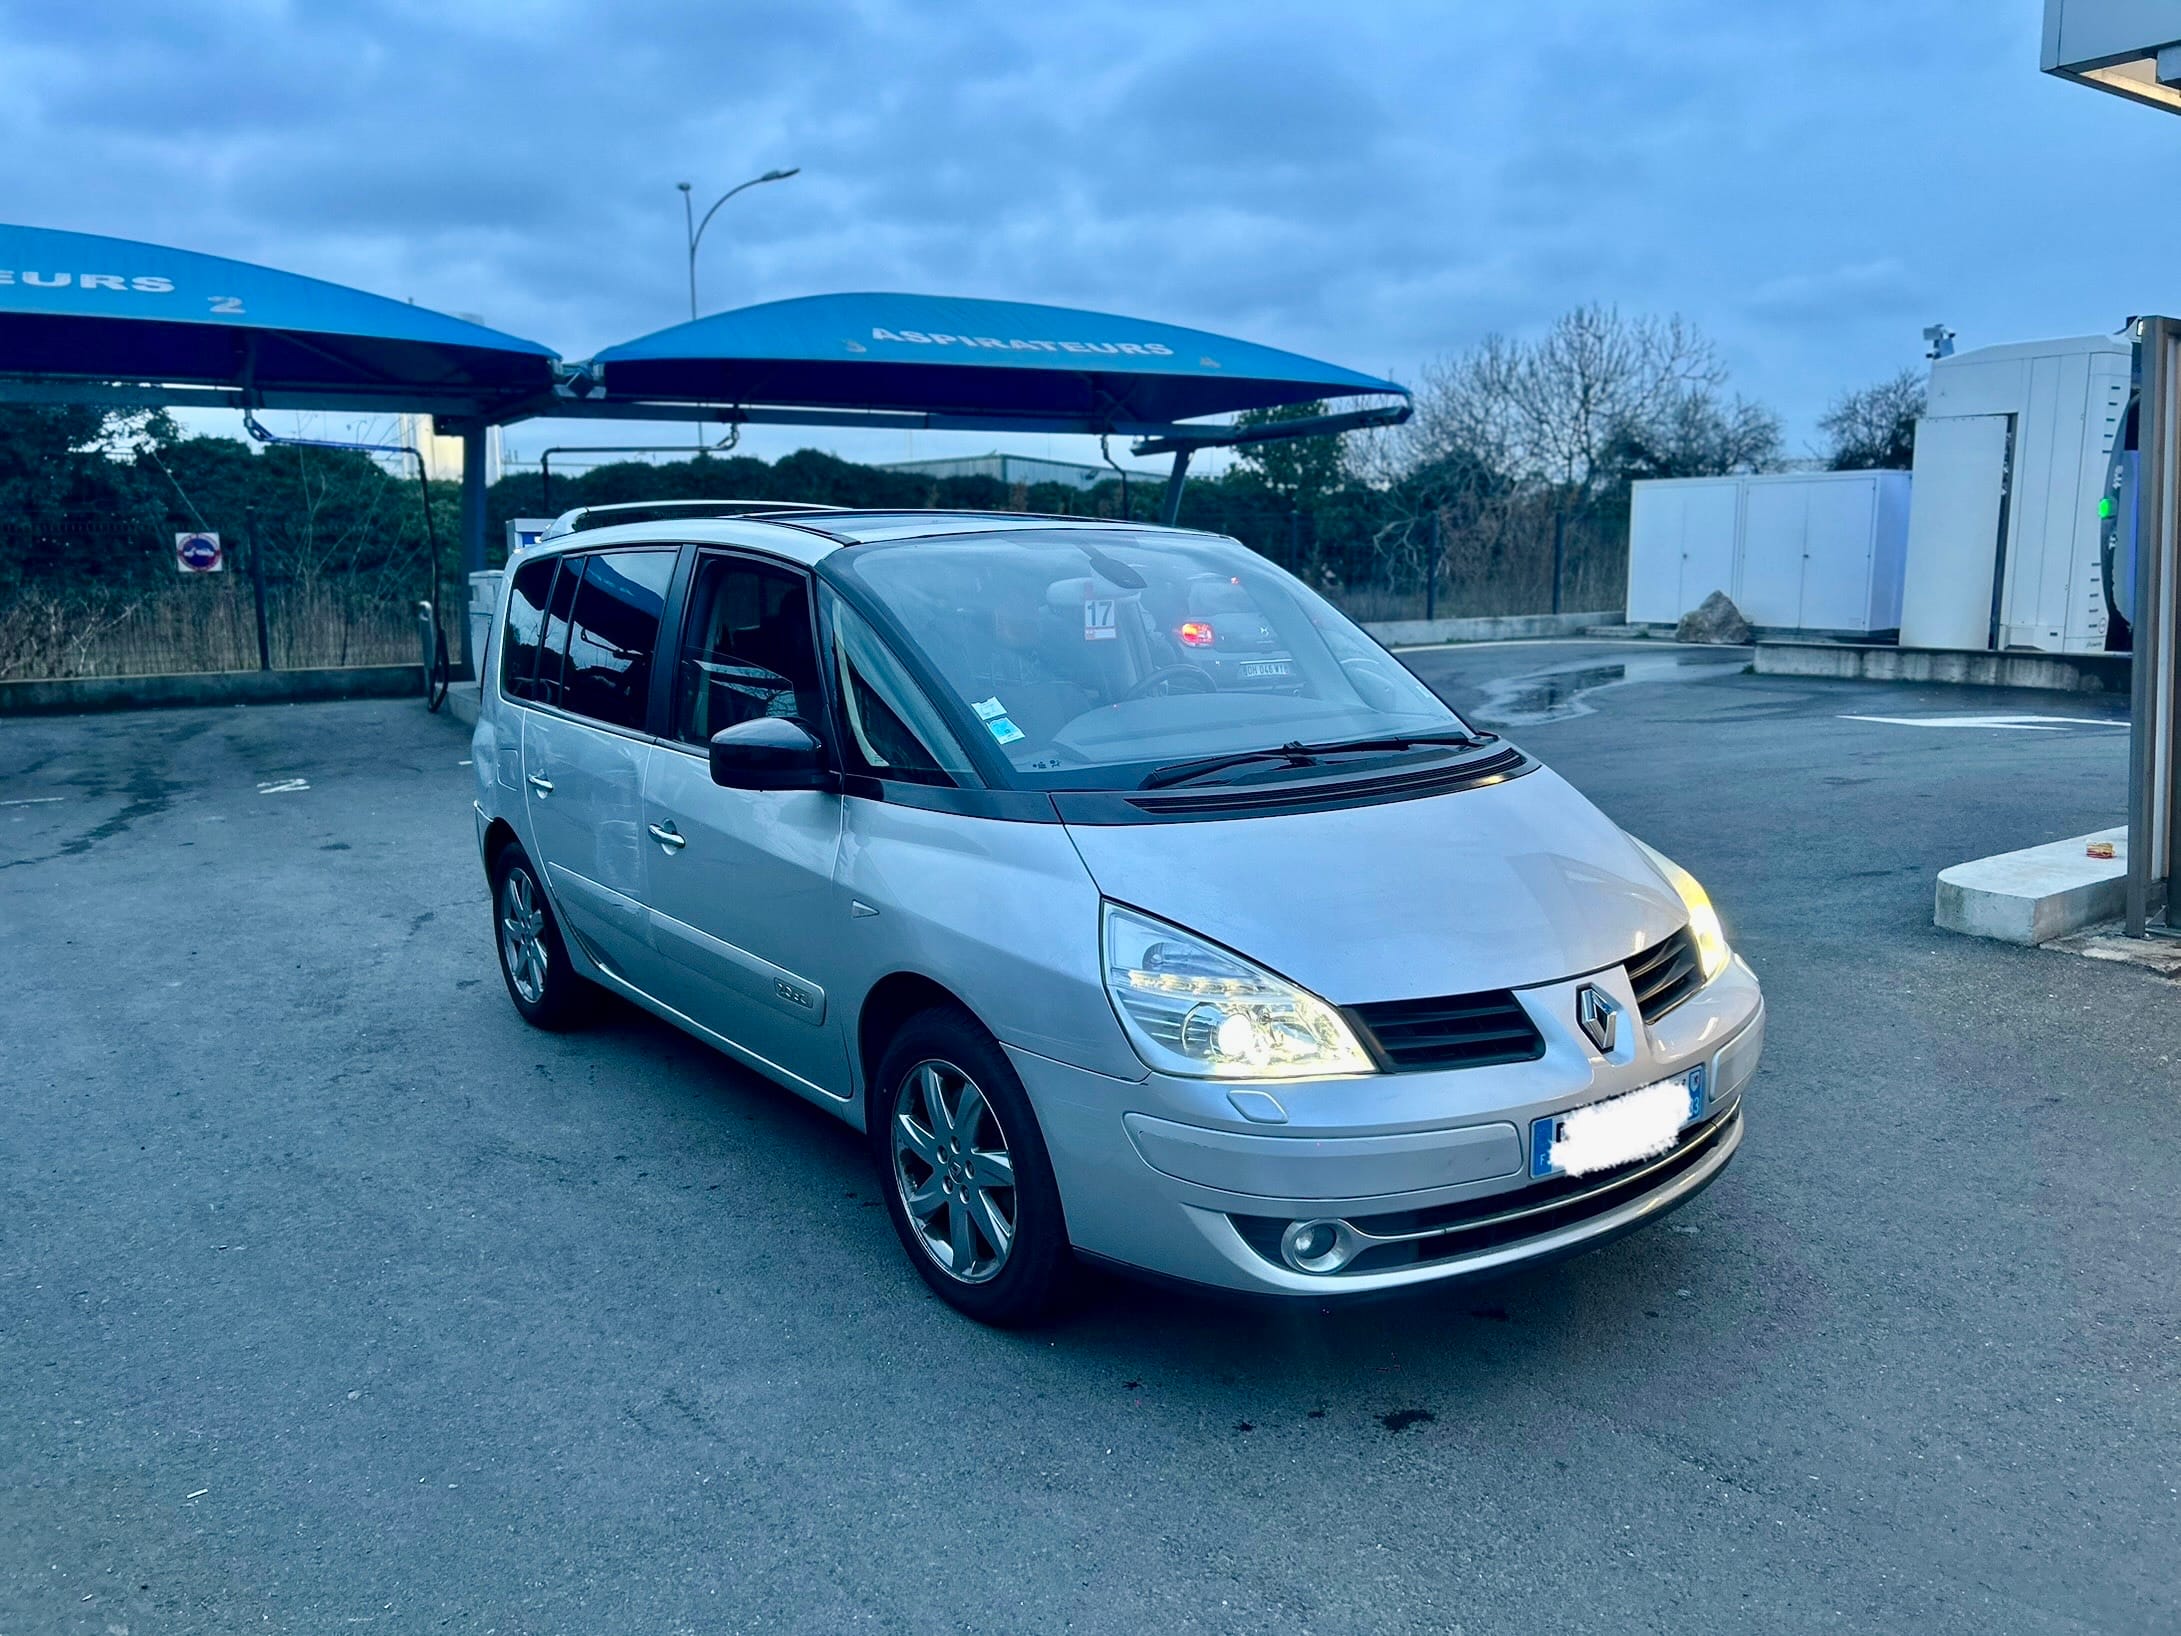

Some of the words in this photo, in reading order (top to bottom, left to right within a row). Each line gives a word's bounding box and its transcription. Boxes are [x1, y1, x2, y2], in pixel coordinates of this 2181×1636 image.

[208, 296, 246, 314] 2
[872, 327, 1174, 355] ASPIRATEURS
[1087, 600, 1113, 626] 17
